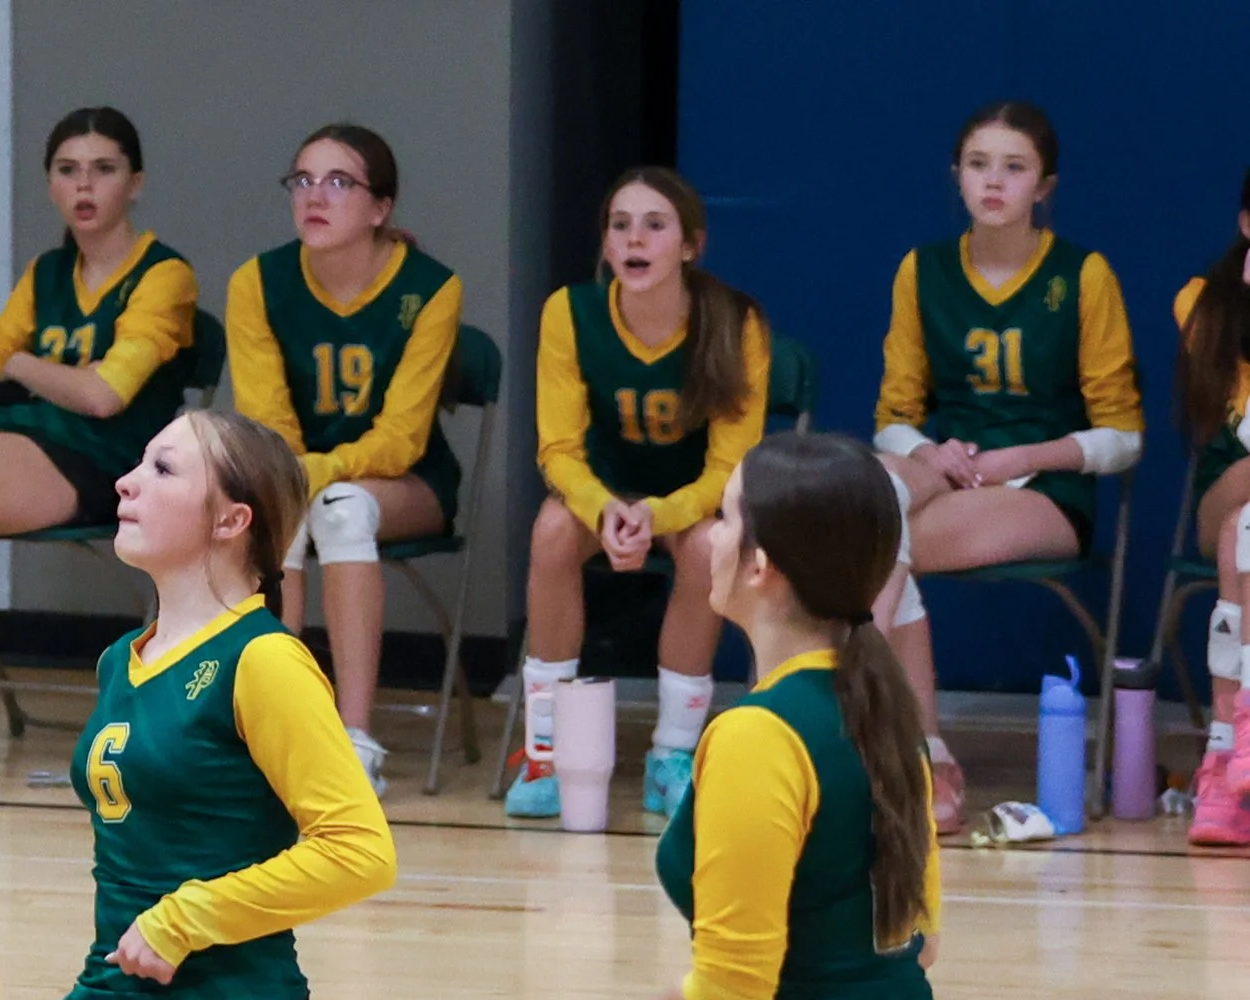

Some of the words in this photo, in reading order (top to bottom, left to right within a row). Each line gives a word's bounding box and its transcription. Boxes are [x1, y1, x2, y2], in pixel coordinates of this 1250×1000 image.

[312, 342, 375, 417] 19
[964, 327, 1030, 396] 31
[614, 387, 686, 446] 18
[86, 722, 132, 824] 6
